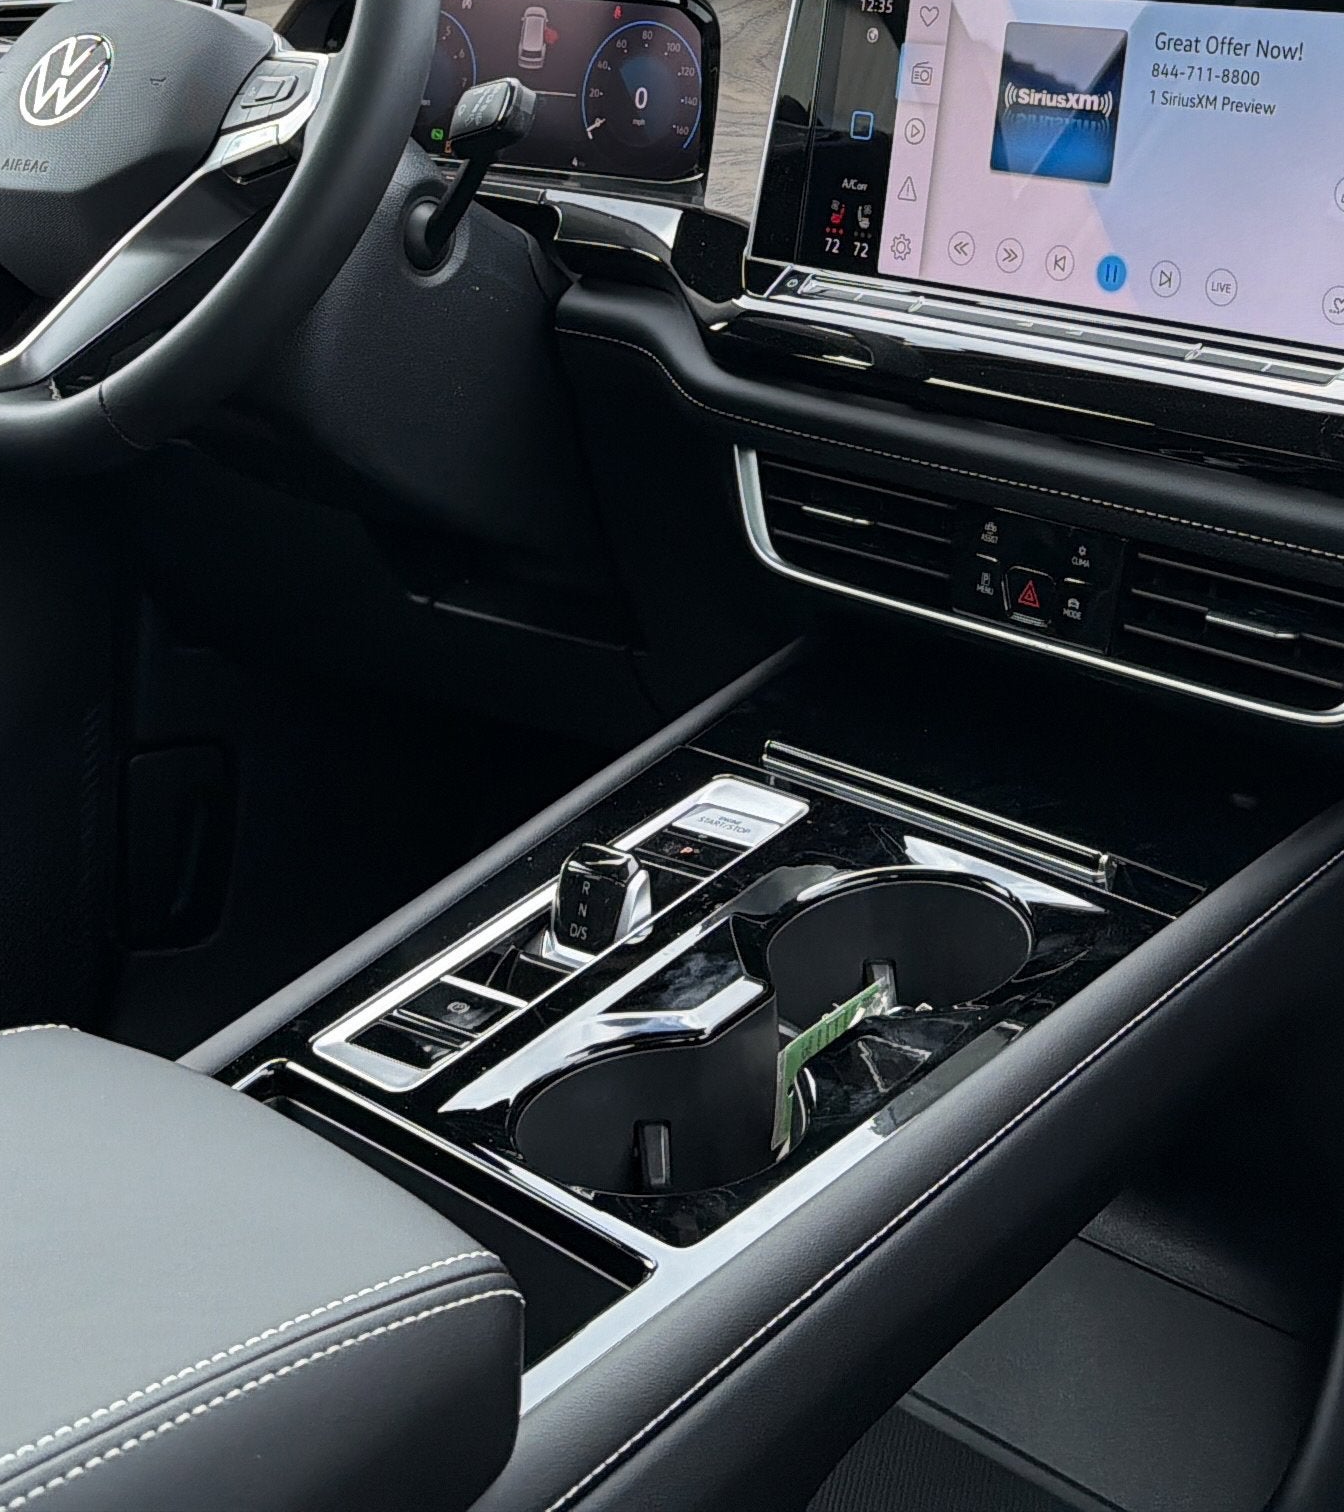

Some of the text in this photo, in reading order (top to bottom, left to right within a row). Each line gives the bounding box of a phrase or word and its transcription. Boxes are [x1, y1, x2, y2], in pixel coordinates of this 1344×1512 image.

[642, 30, 654, 40] 80
[616, 39, 627, 49] 60
[666, 42, 681, 53] 100
[1154, 31, 1304, 62] Great Offer Now!
[459, 48, 466, 59] 6
[597, 60, 609, 71] 40
[681, 66, 696, 78] 120
[1150, 62, 1261, 87] 844-711-8800
[588, 88, 601, 99] 20
[634, 86, 648, 110] 0
[683, 96, 698, 107] 140
[1149, 89, 1277, 116] 1 SiriusXM Preview
[675, 125, 690, 137] 160
[1, 156, 50, 175] AIRBAG
[824, 237, 869, 258] 72 72
[1211, 281, 1232, 294] LIVE
[1062, 608, 1082, 621] MODE
[697, 816, 752, 834] START/STOP
[582, 880, 591, 896] R
[578, 904, 588, 918] N
[569, 922, 588, 941] D/S
